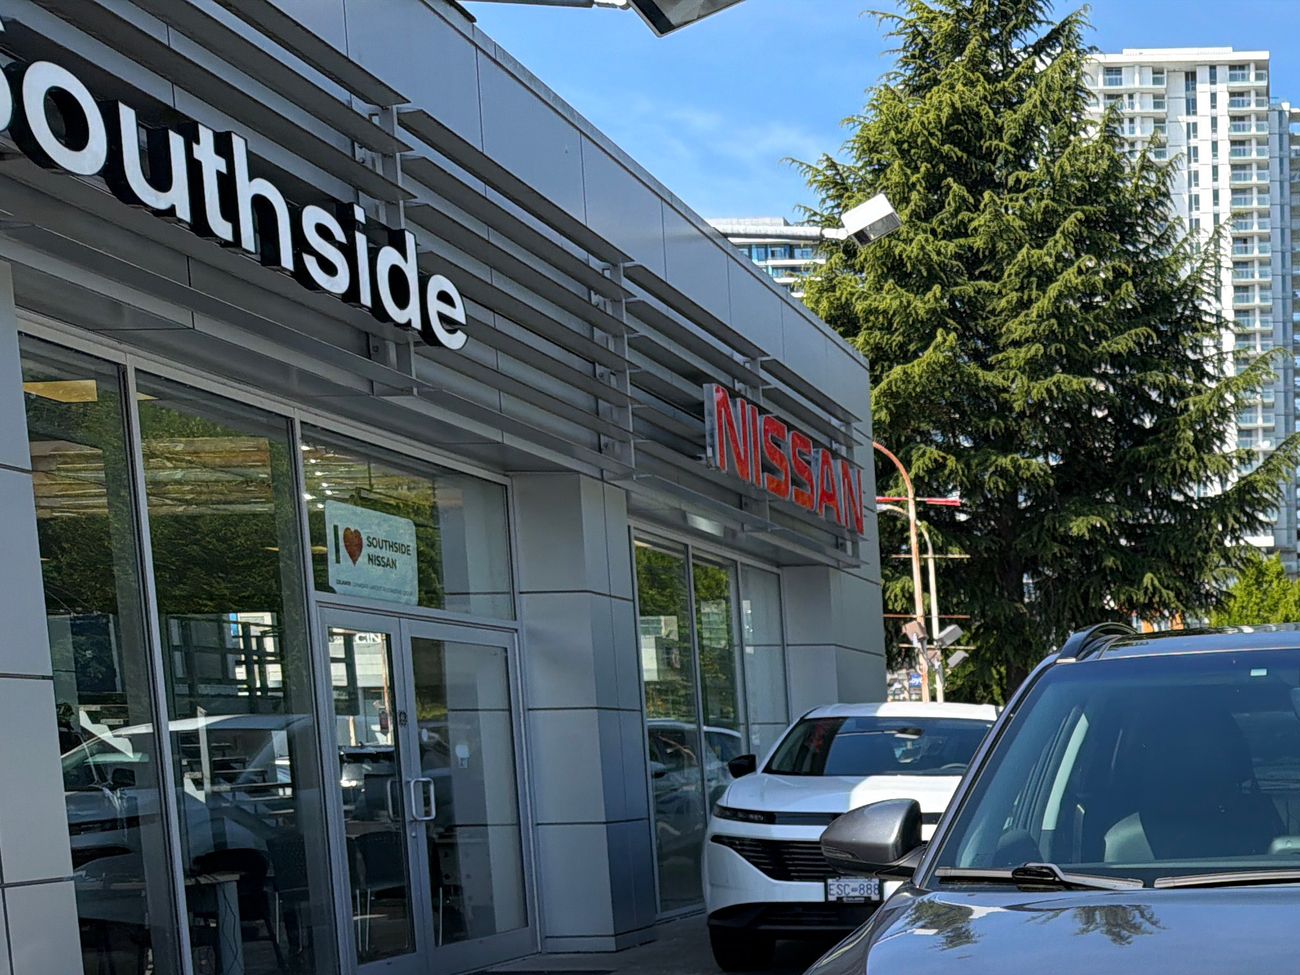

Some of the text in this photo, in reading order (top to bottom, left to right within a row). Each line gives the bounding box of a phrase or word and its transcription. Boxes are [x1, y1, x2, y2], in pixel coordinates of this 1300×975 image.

[0, 16, 469, 351] outhside
[712, 384, 865, 536] NISSAN
[333, 525, 412, 564] I SOUTHSIDE
[367, 553, 398, 570] NISSAN
[828, 883, 850, 896] ESC
